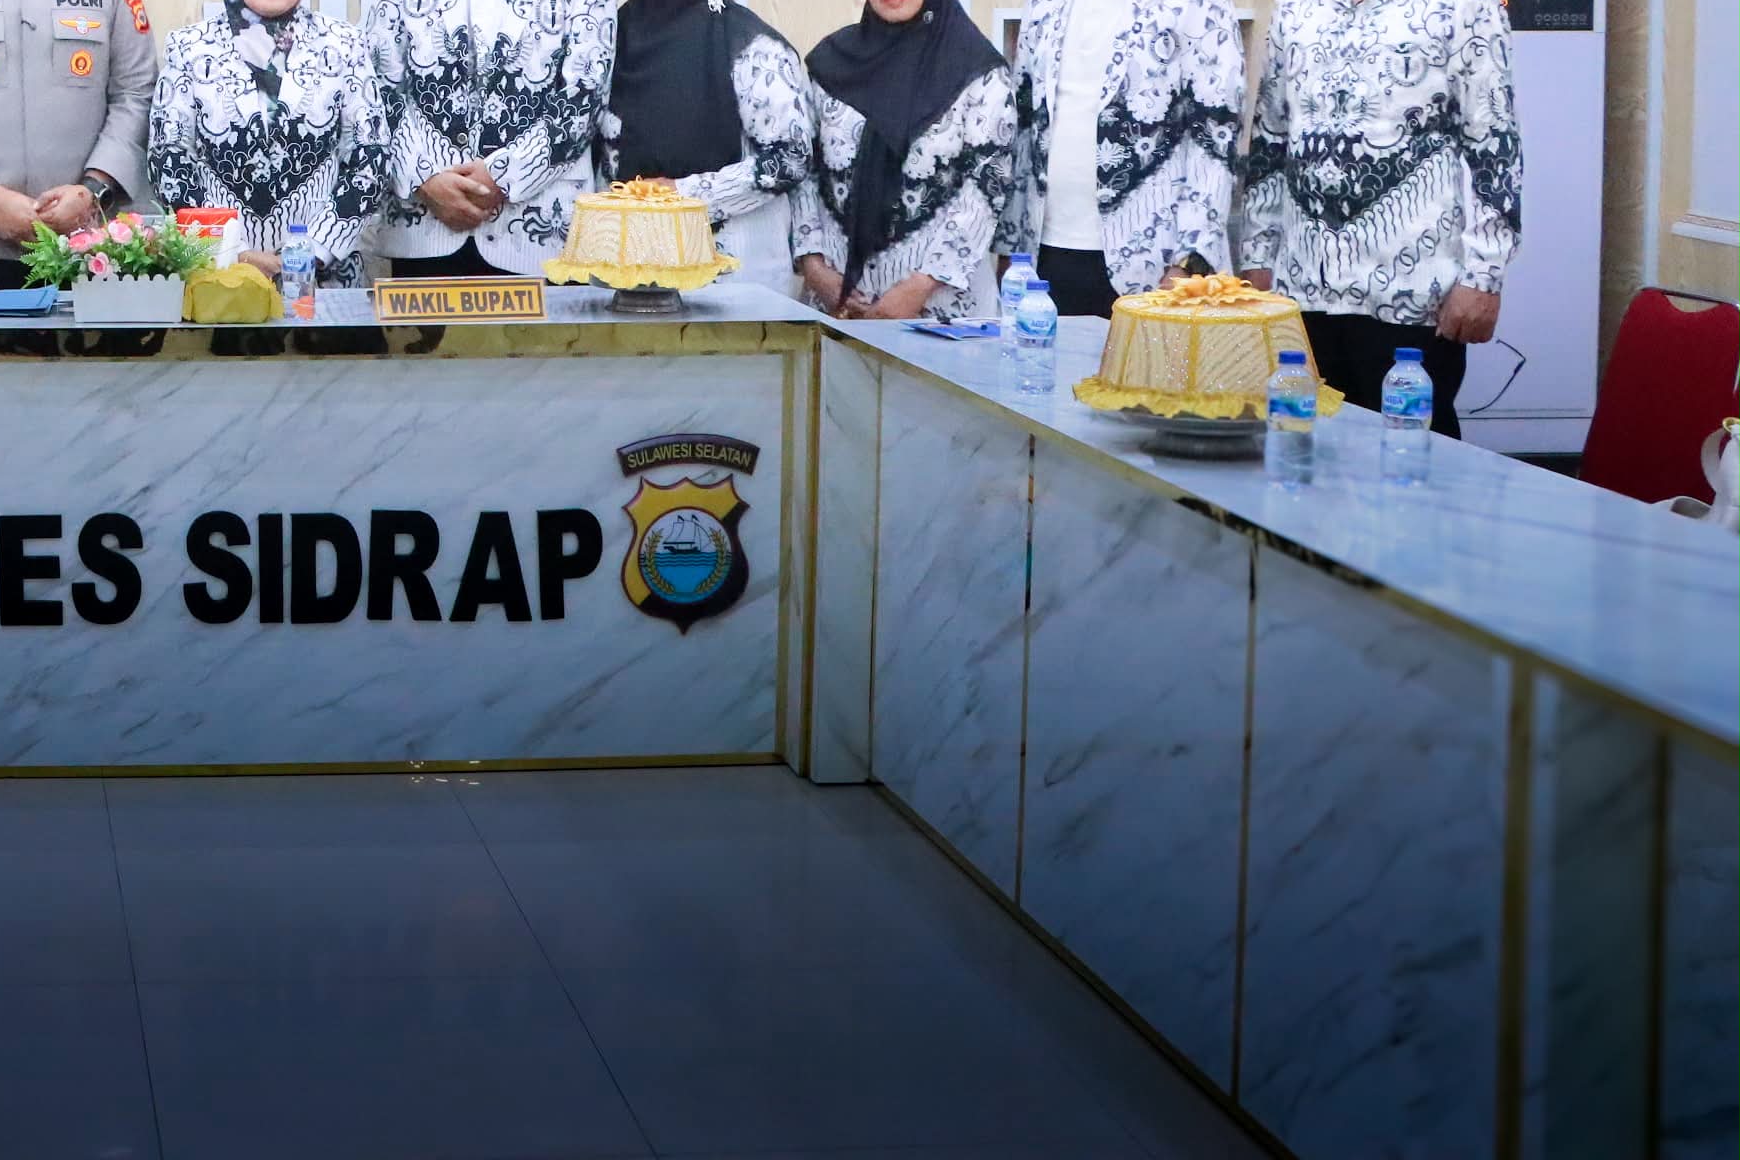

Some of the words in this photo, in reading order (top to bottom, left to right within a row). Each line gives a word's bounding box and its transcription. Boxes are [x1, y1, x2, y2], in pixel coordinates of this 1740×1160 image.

[389, 292, 456, 314] WAKIL
[460, 290, 534, 313] BUPATI
[627, 443, 692, 468] SULAWESI
[695, 443, 752, 467] SELATAN
[182, 508, 604, 625] SIDRAP
